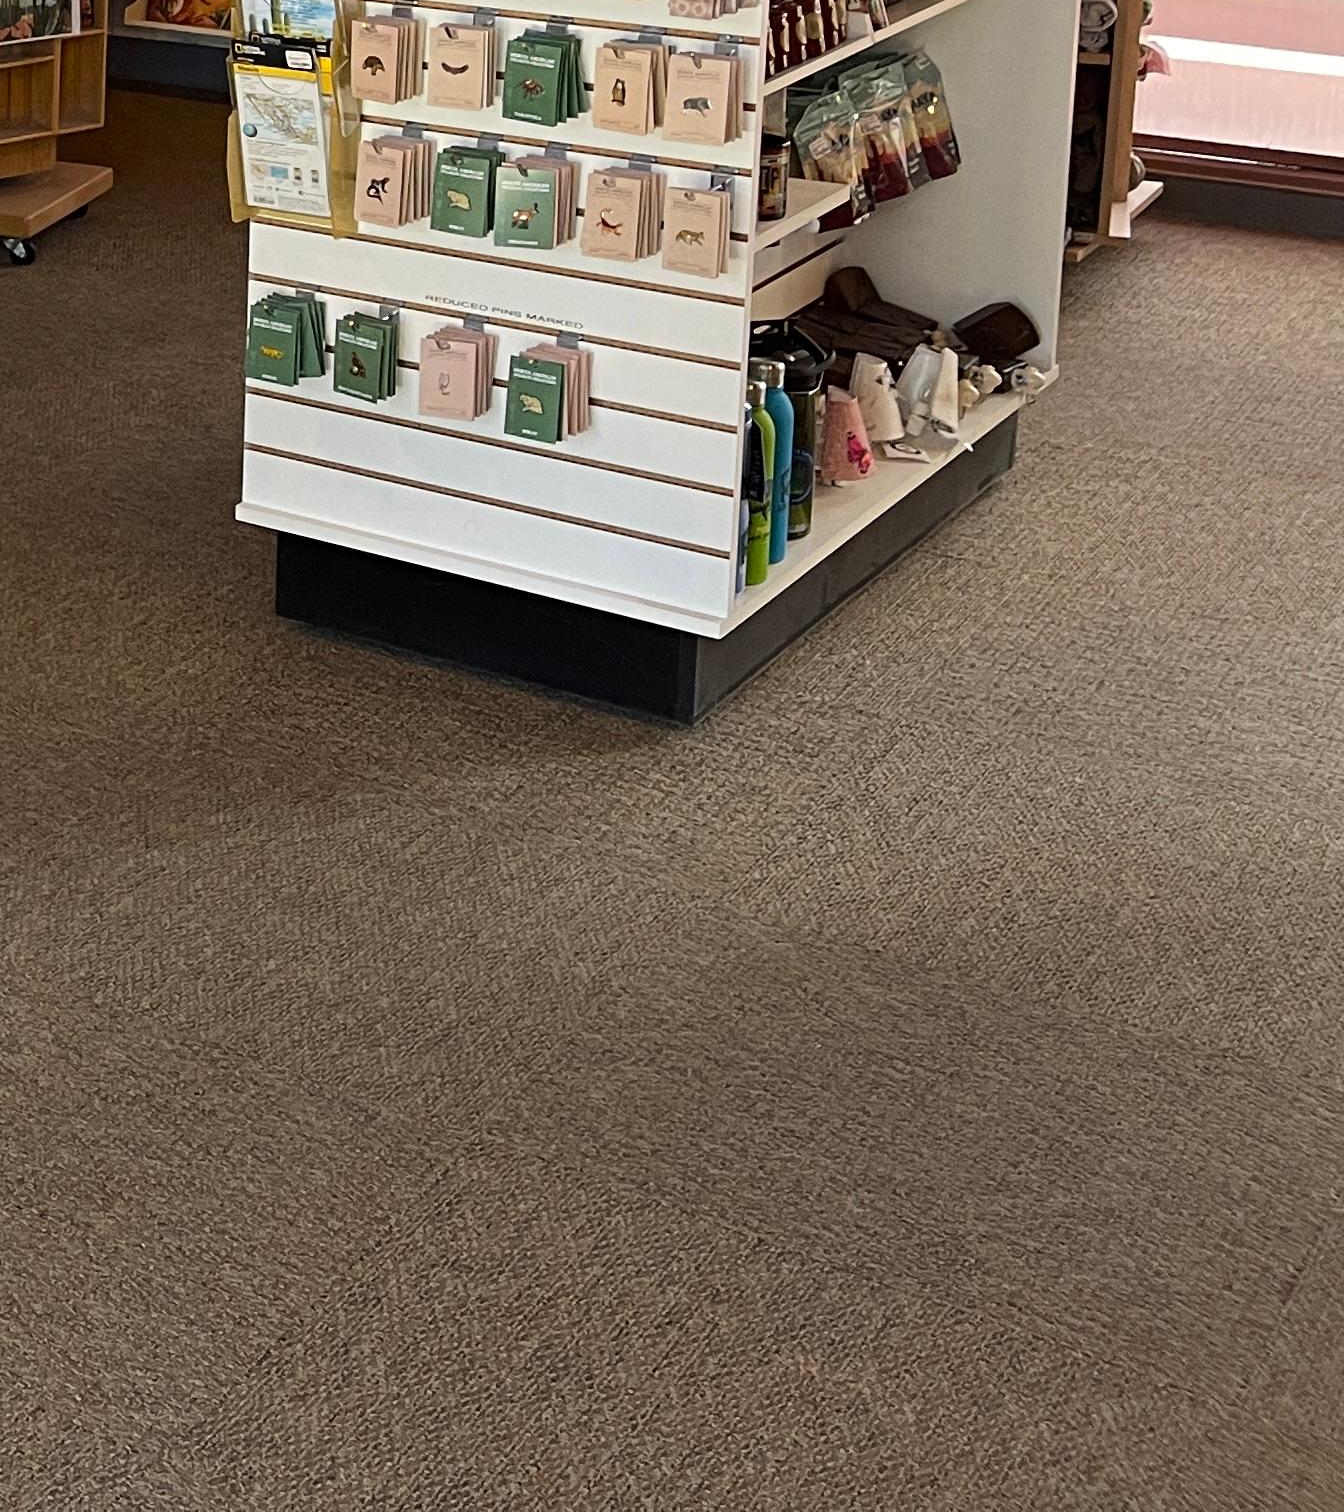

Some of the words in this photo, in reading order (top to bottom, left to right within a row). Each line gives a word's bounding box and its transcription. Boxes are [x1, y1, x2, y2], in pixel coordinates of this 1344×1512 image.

[424, 294, 489, 312] REDUCED
[491, 306, 522, 318] PINS
[525, 313, 584, 330] MARKED
